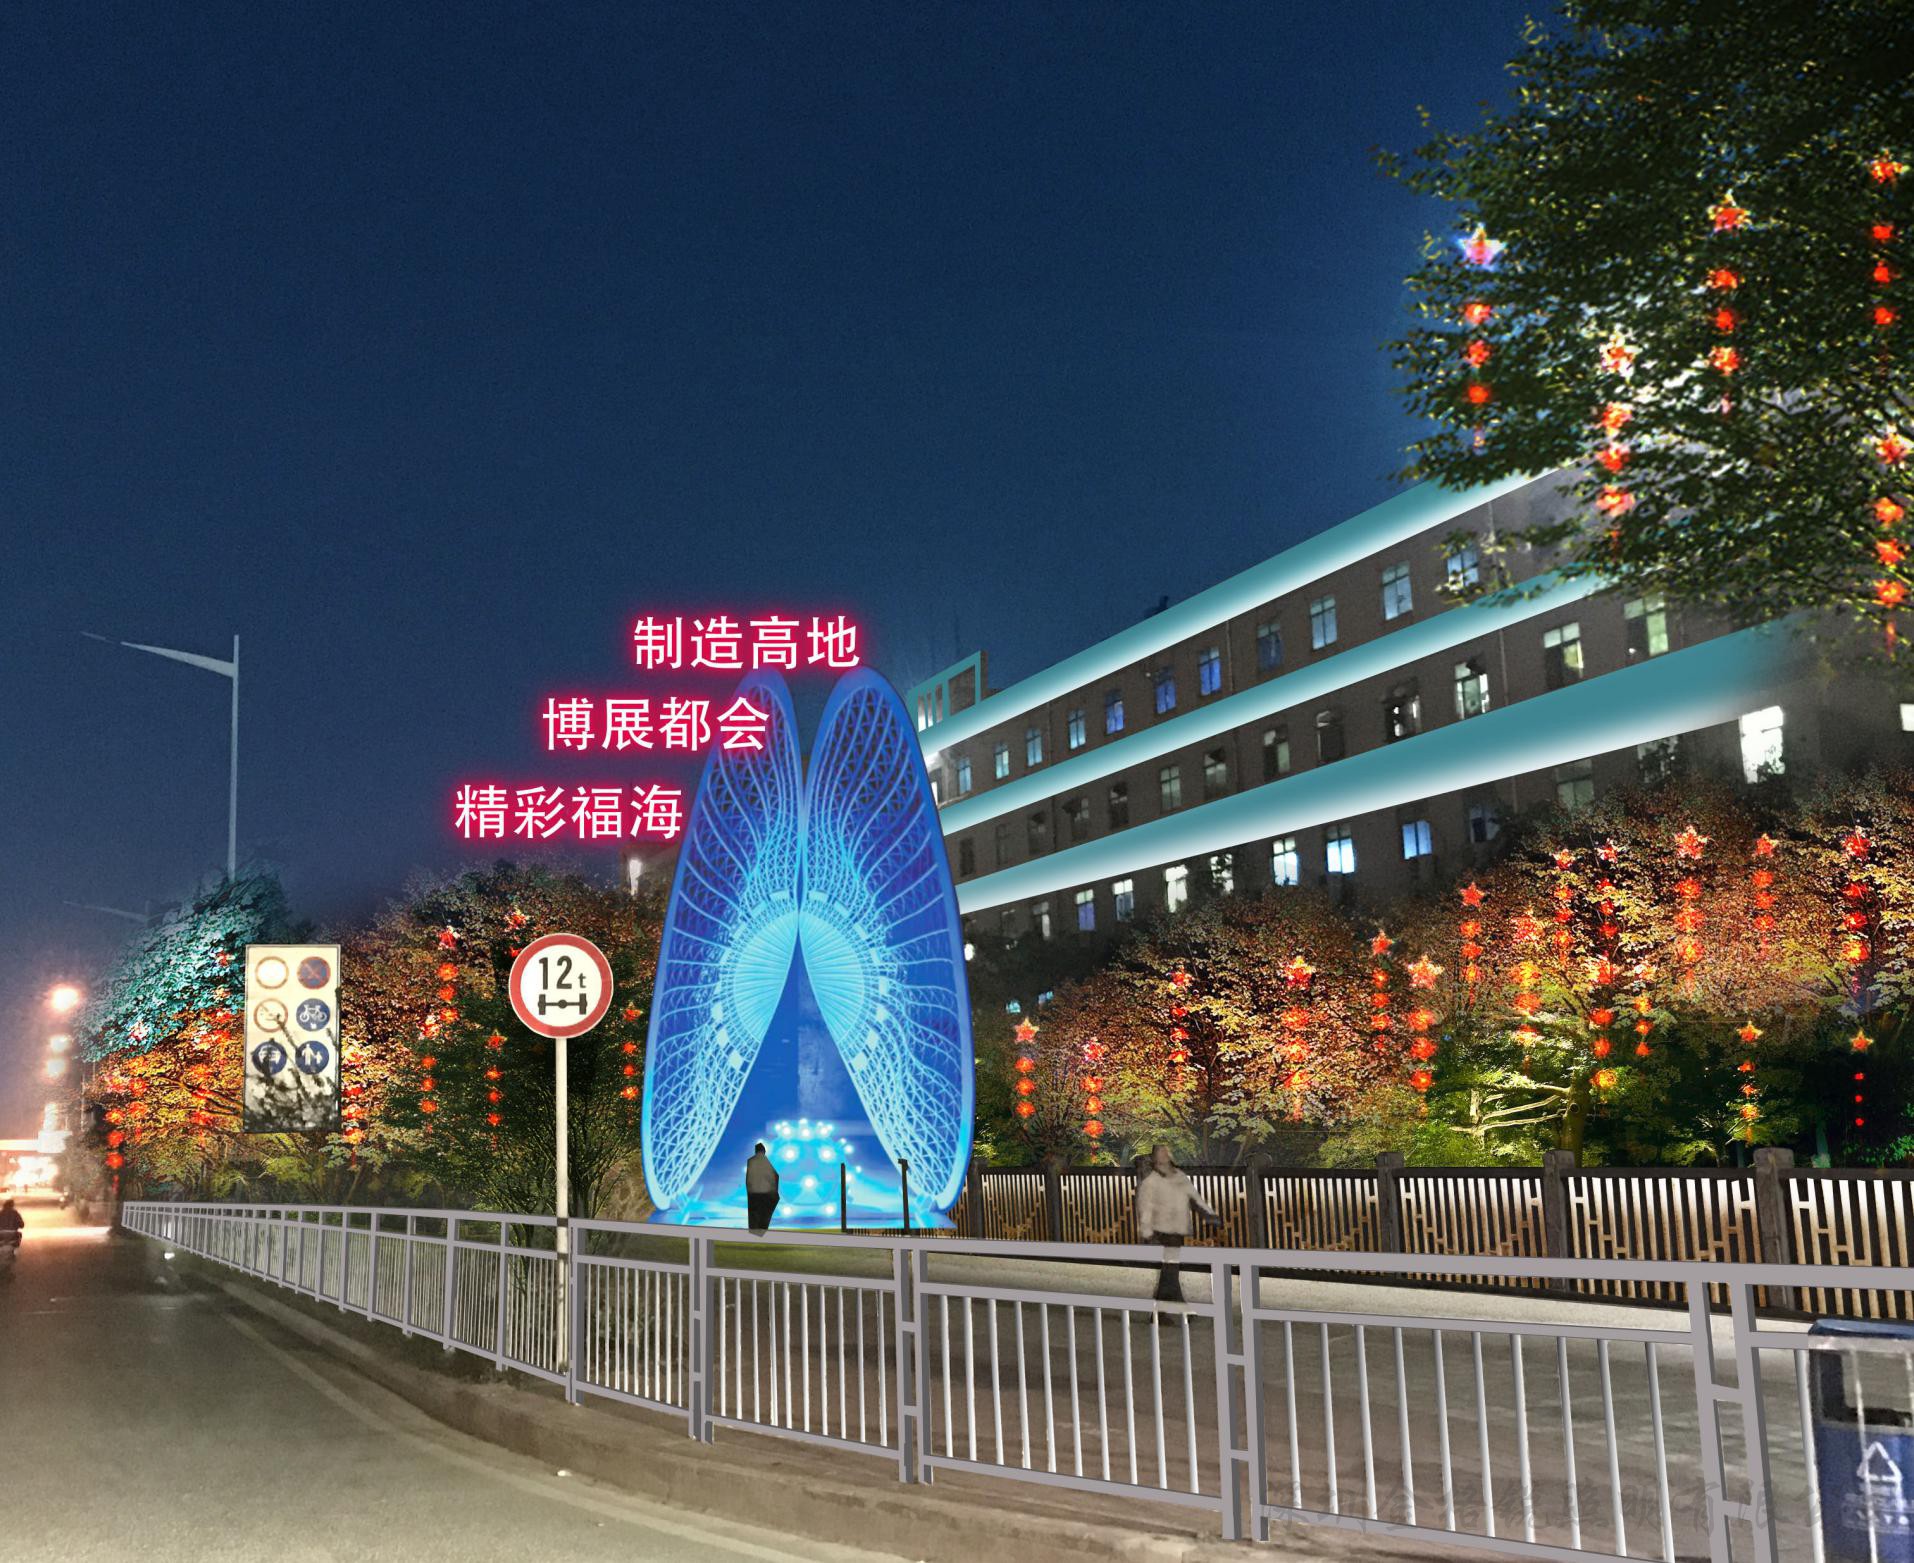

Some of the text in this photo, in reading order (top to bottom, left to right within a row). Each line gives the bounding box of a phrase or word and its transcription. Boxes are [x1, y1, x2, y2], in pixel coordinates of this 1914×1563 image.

[635, 616, 859, 669] 制造高地
[543, 697, 768, 750] 博展都会
[456, 785, 682, 838] 精彩福海
